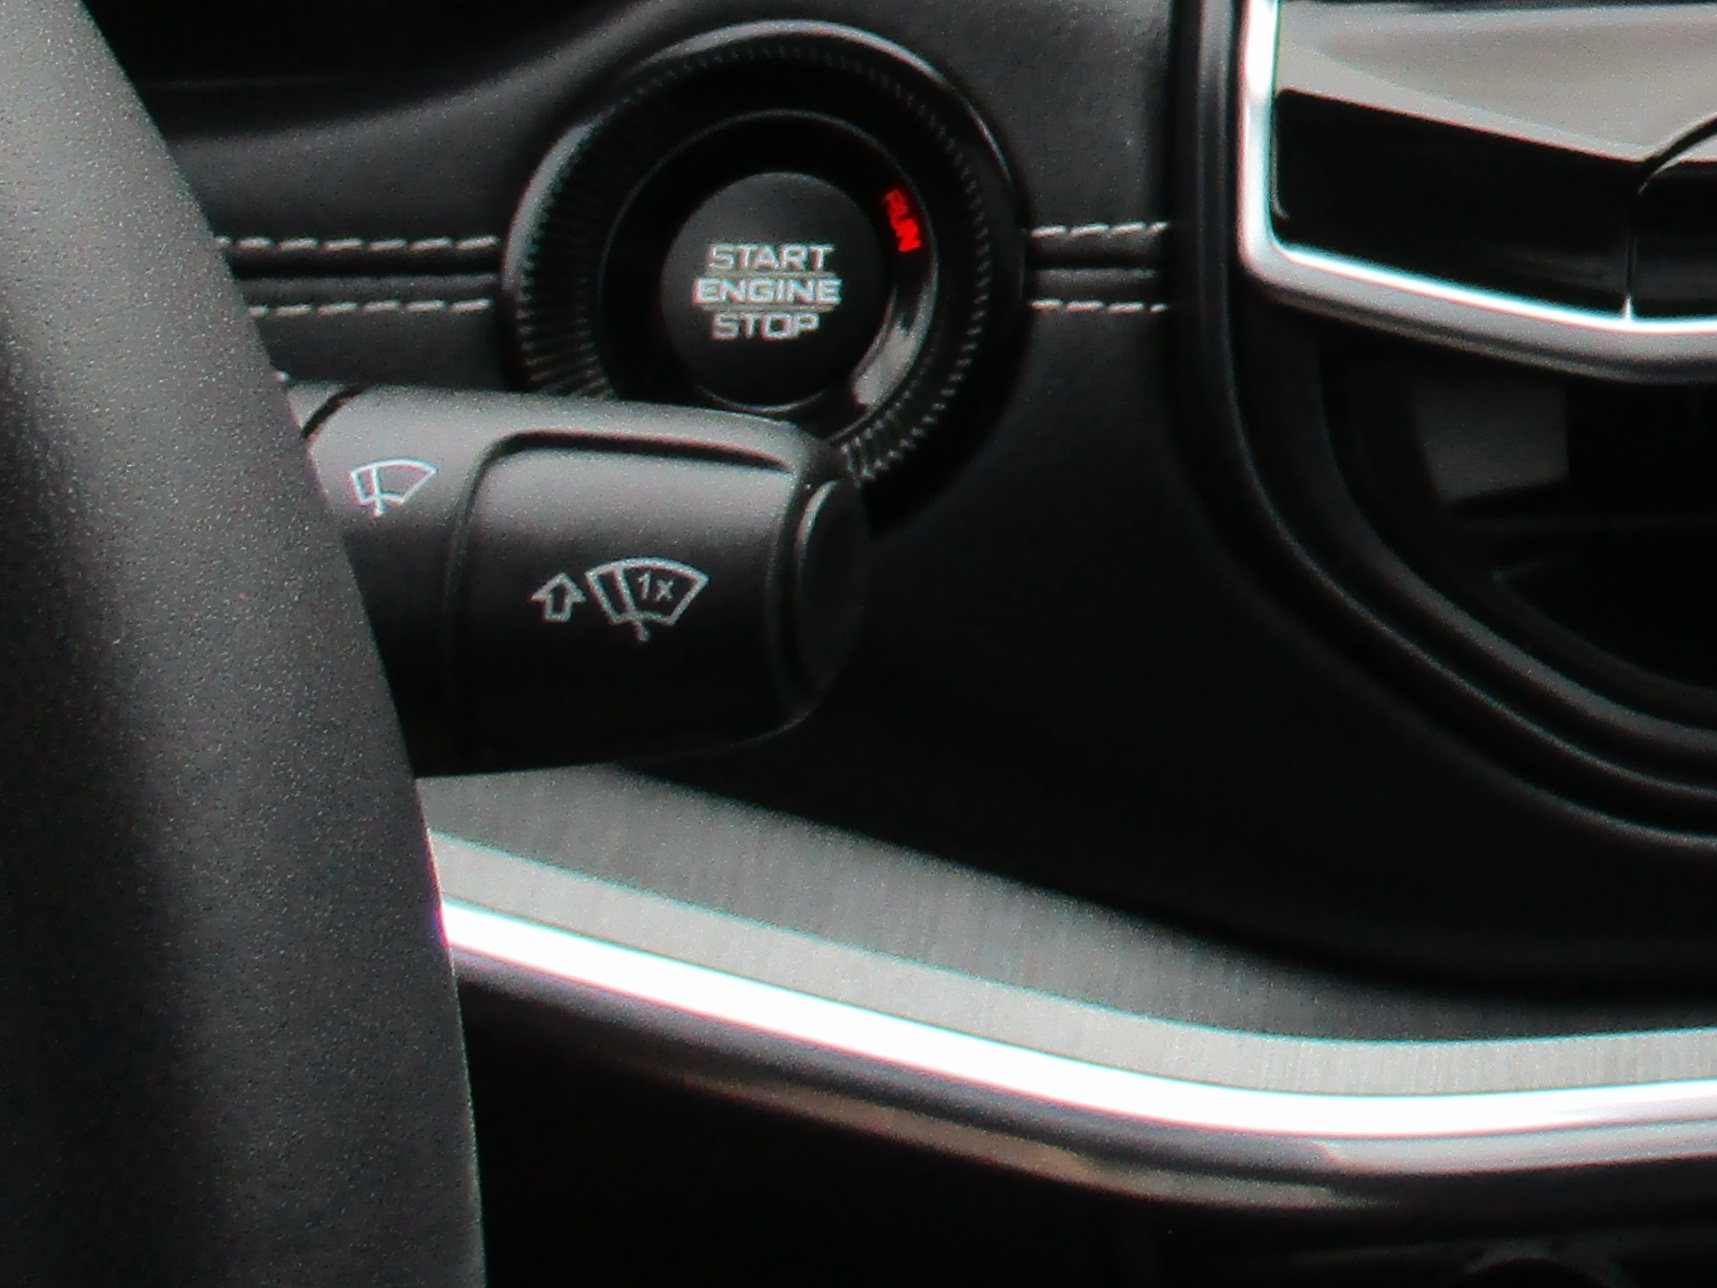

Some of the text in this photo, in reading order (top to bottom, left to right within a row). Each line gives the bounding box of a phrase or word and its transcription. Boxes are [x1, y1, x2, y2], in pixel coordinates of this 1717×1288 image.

[708, 243, 834, 271] START
[693, 277, 842, 305] ENGINE
[712, 313, 820, 341] STOP
